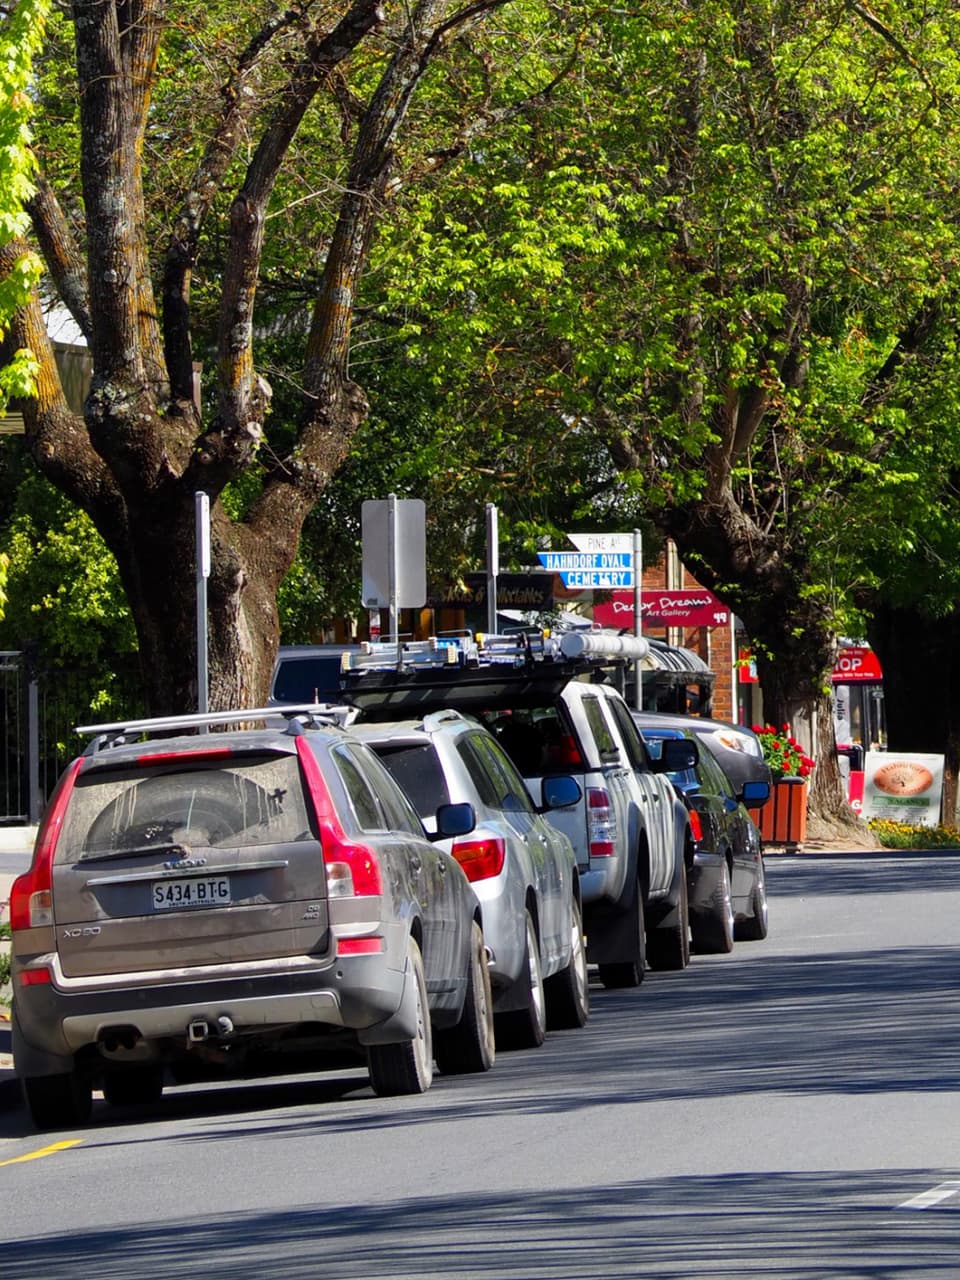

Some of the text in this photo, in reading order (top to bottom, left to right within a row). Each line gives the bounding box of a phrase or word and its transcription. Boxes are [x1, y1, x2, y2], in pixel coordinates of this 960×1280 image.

[546, 553, 625, 569] HAHNDORF OVAL
[567, 572, 625, 586] CEMETERY
[659, 595, 713, 609] Dreams
[646, 609, 691, 618] Art Gallery
